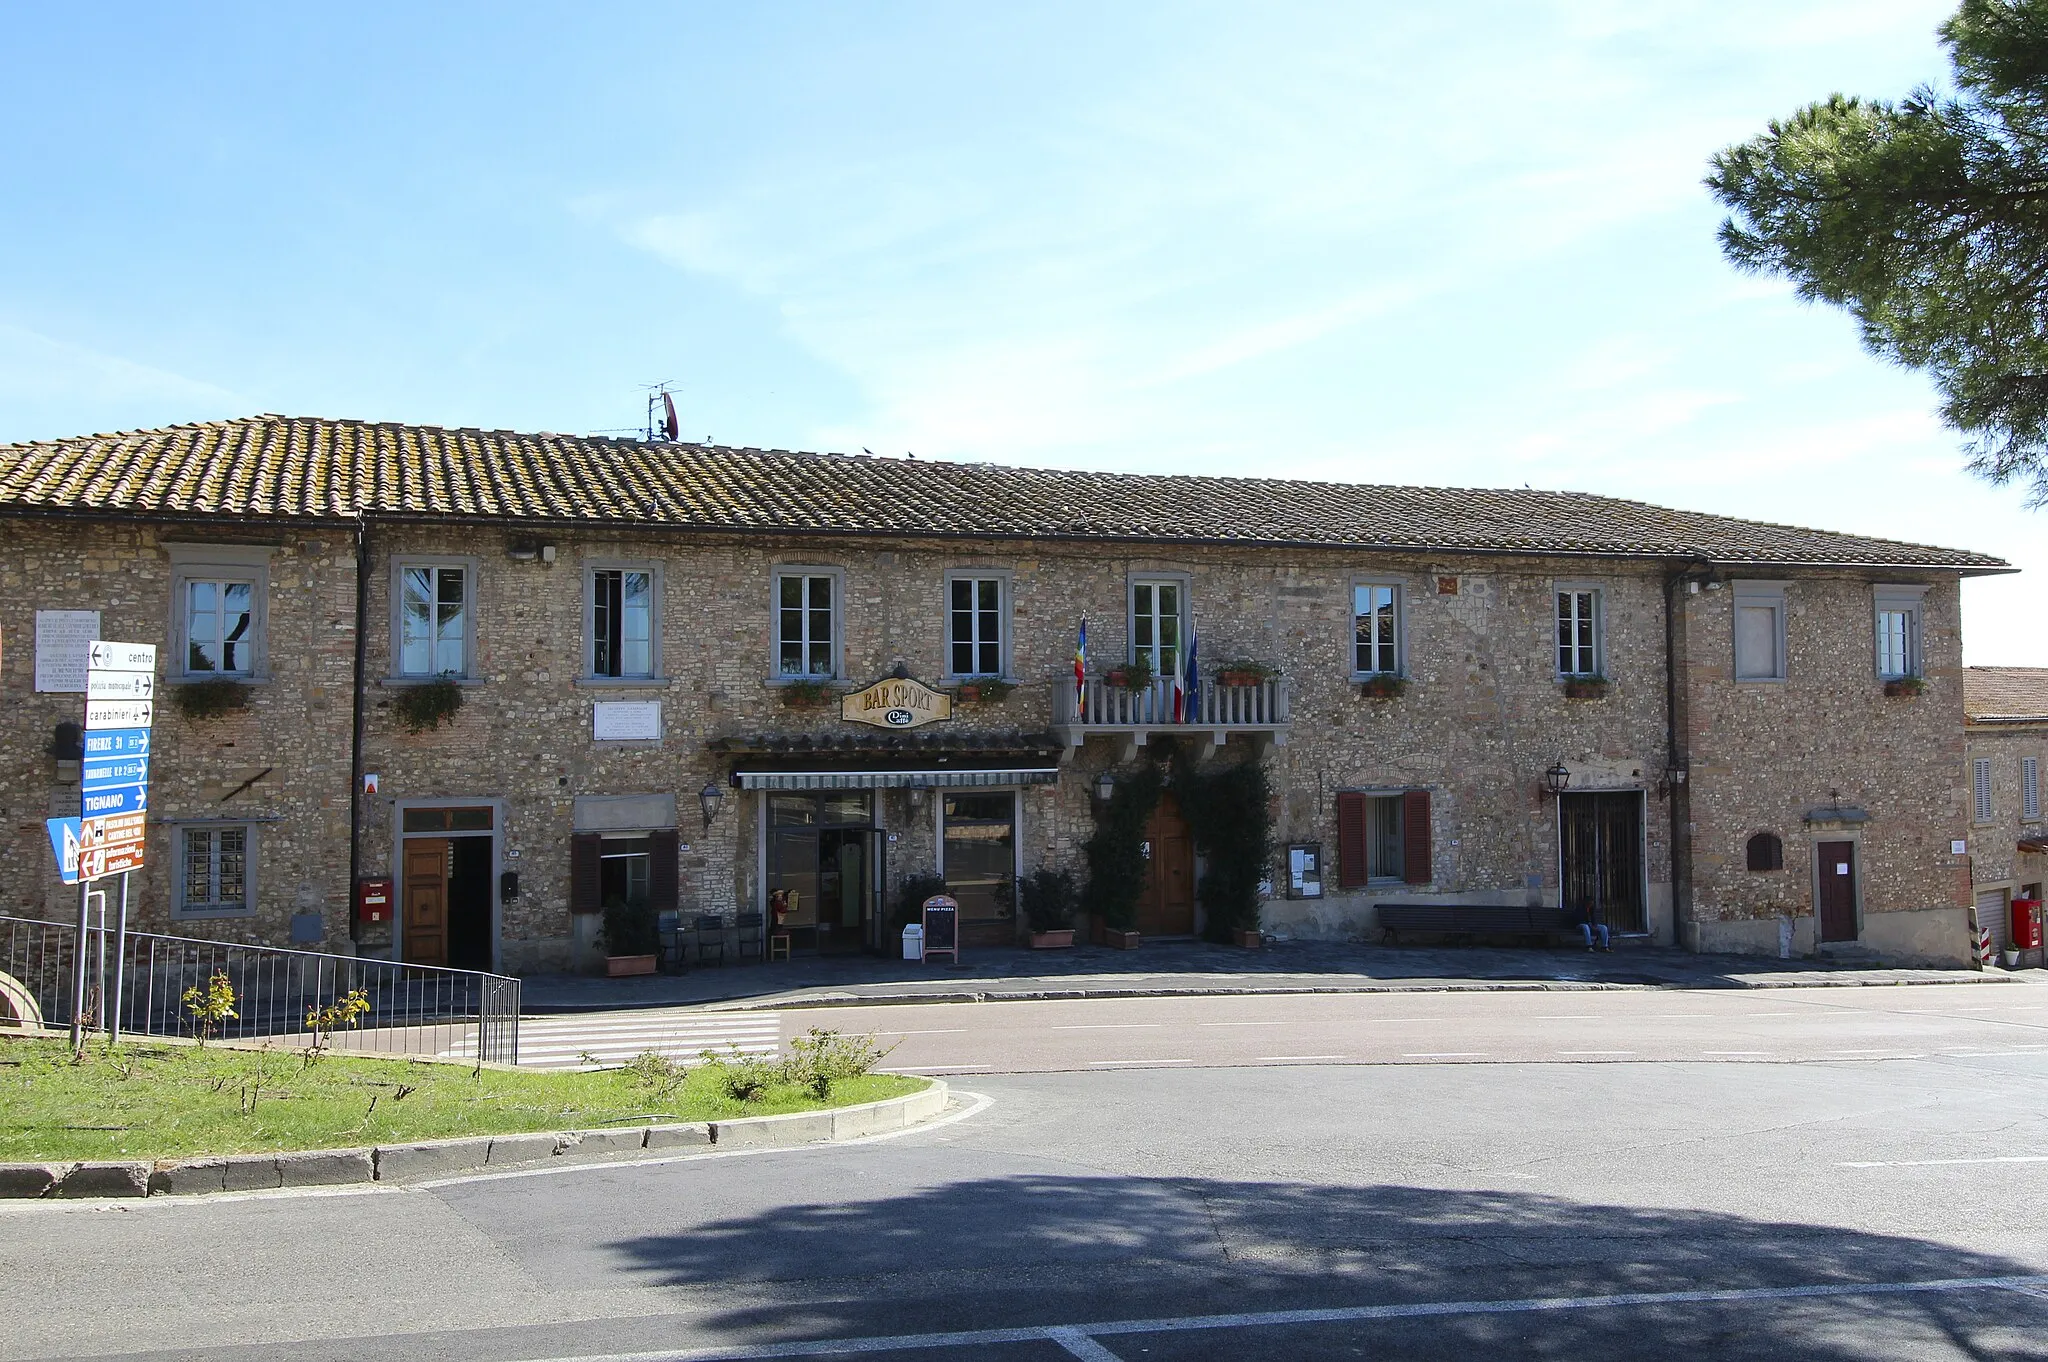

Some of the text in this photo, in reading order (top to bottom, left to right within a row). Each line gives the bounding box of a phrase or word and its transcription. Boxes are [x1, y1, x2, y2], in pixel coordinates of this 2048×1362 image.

[128, 652, 153, 663] centro
[108, 680, 132, 692] municipale
[863, 684, 932, 711] BAR SPORT
[90, 708, 132, 721] carabinieri
[87, 736, 112, 752] FIRENZE
[115, 736, 123, 750] 31
[85, 793, 124, 811] TIGNANO
[108, 857, 132, 871] turistiche
